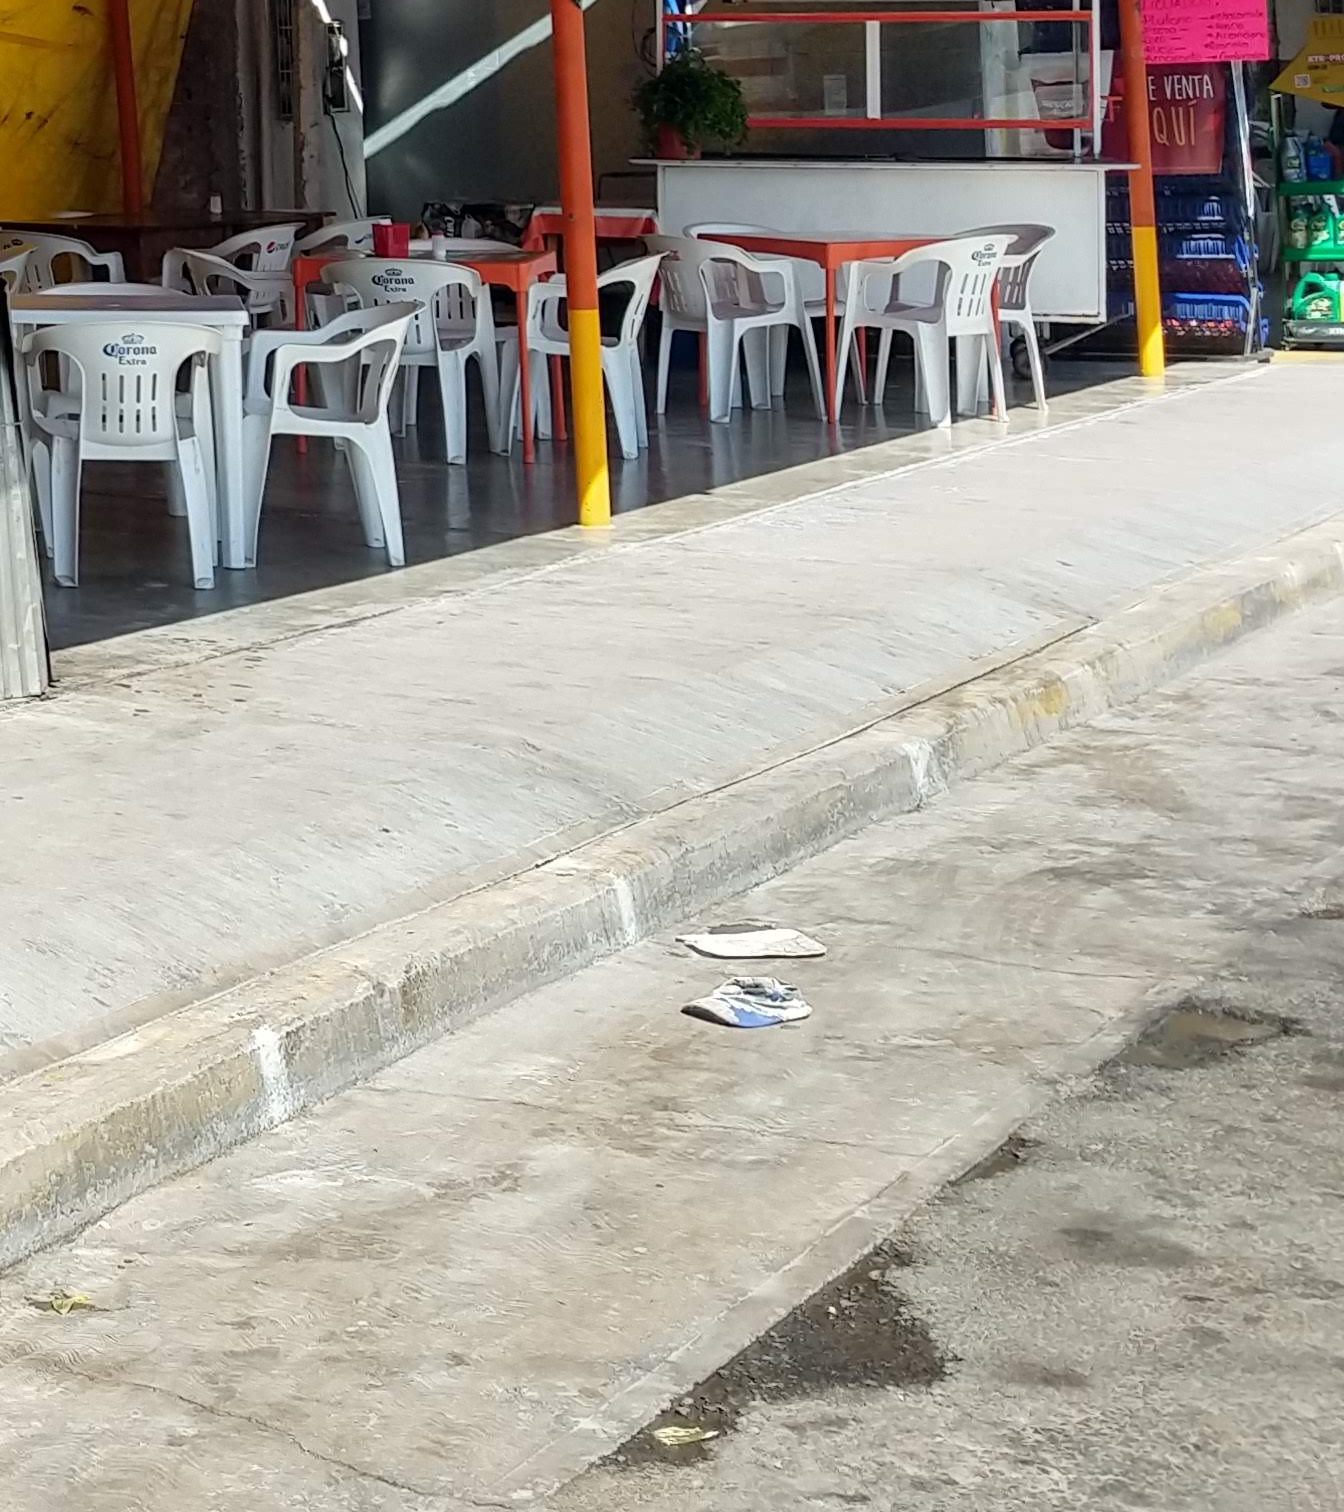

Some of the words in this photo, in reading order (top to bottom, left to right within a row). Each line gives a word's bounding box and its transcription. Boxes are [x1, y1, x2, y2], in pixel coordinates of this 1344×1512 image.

[1148, 77, 1157, 101] E
[1164, 74, 1213, 101] VENTA
[1153, 100, 1197, 146] QUÍ
[371, 274, 415, 286] Corona
[102, 343, 158, 358] Corona
[118, 356, 147, 366] Extra
